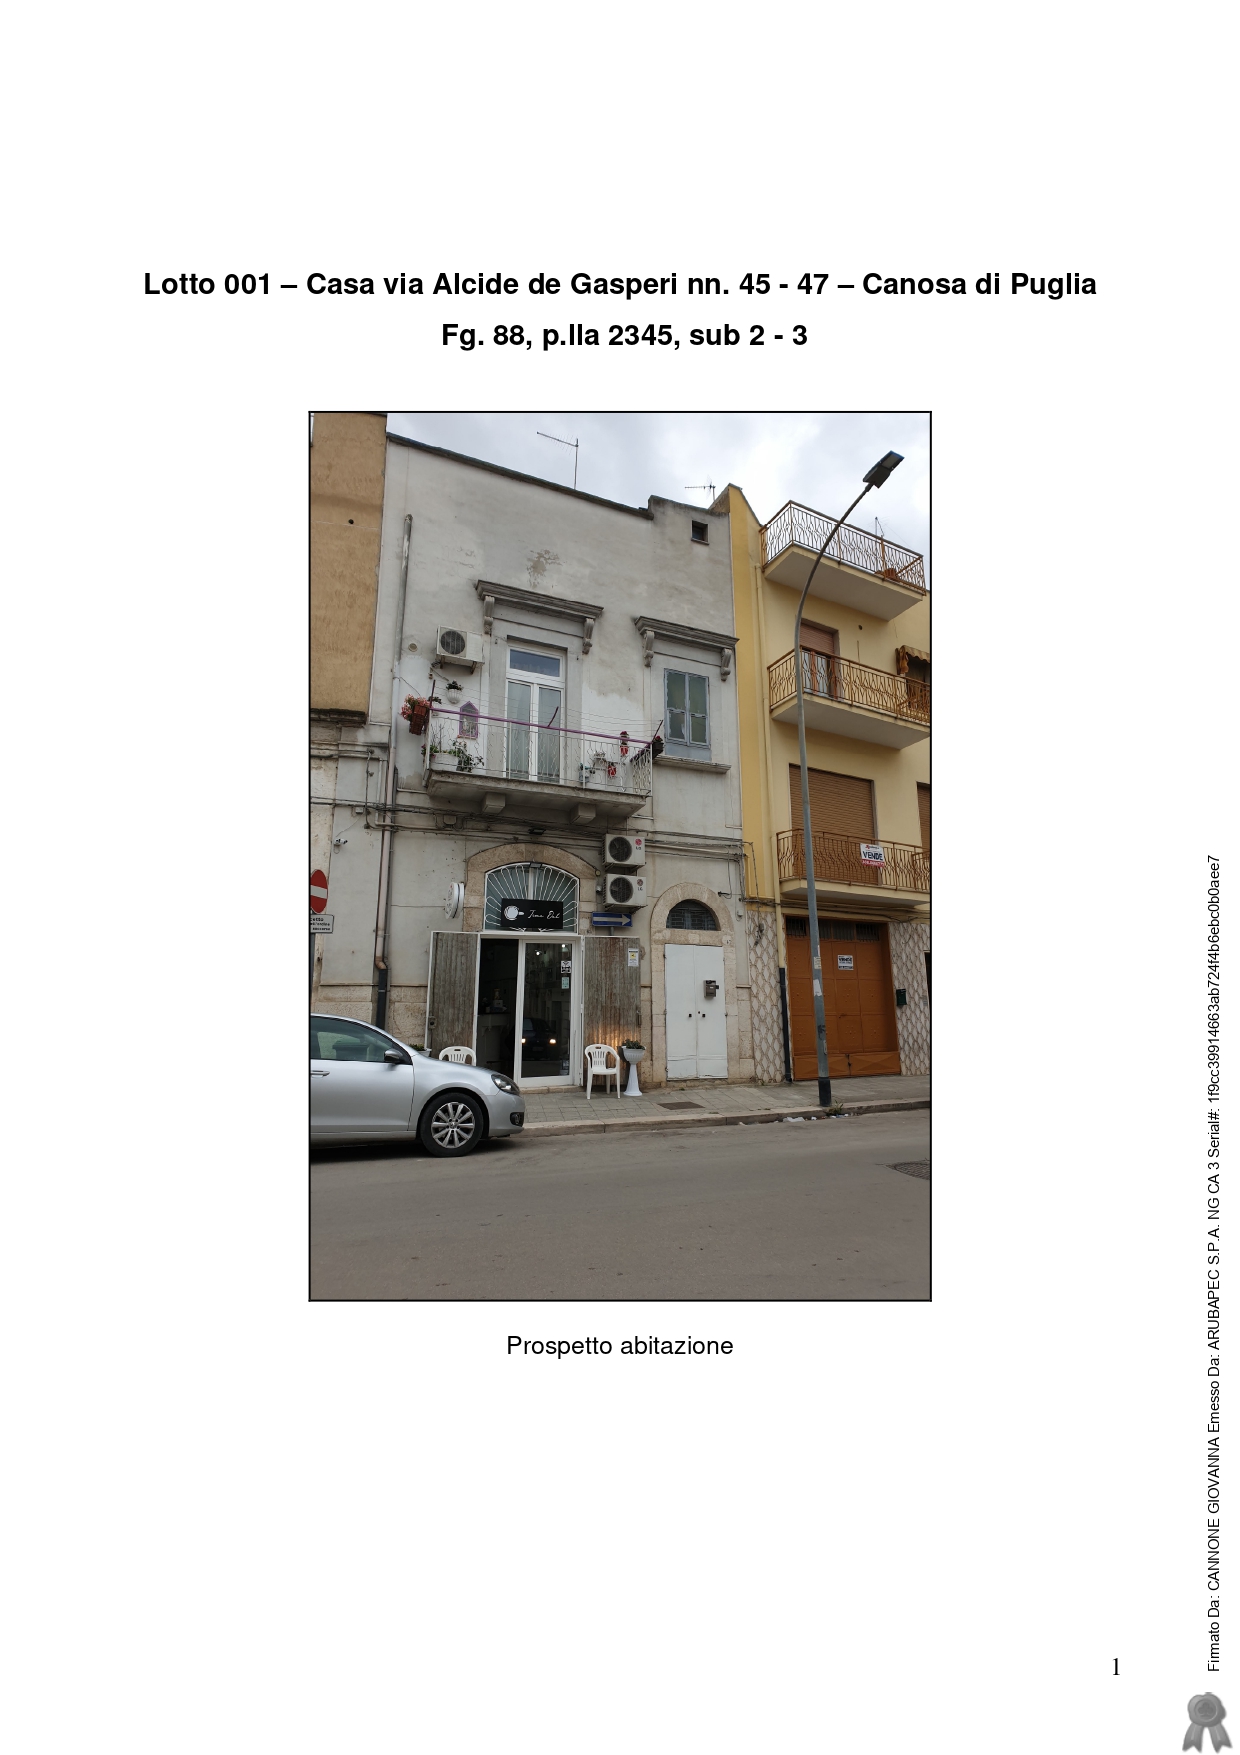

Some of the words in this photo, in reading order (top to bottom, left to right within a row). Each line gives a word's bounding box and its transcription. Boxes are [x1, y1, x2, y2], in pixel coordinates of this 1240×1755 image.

[145, 273, 215, 294] Lotto
[225, 273, 268, 294] 001
[307, 273, 374, 294] Casa
[383, 273, 423, 294] via
[433, 273, 518, 294] Alcide
[529, 273, 560, 294] de
[571, 273, 676, 300] Gasperi
[689, 278, 728, 294] nn.
[740, 273, 770, 294] 45
[798, 273, 828, 294] 47
[863, 273, 966, 294] Canosa
[976, 273, 999, 294] di
[1012, 273, 1096, 300] Puglia
[443, 324, 483, 351] Fg.
[494, 325, 531, 350] 88,
[544, 324, 599, 351] p.lla
[609, 324, 679, 350] 2345,
[690, 324, 740, 345] sub
[750, 325, 764, 345] 2
[793, 325, 807, 345] 3
[862, 851, 884, 861] VENDE
[508, 1336, 612, 1359] Prospetto
[621, 1336, 733, 1354] abitazione
[1113, 1658, 1120, 1675] 1
